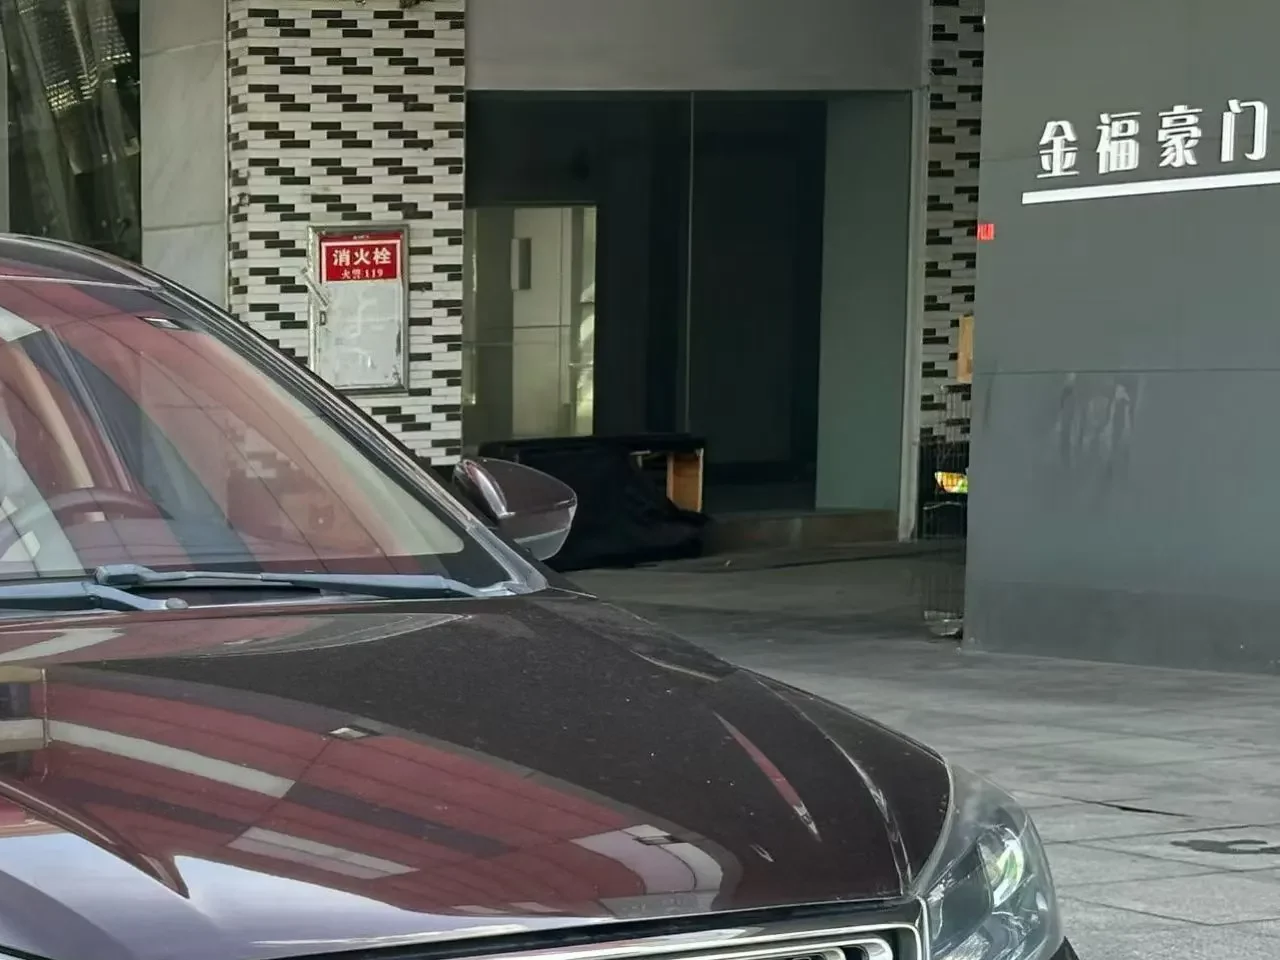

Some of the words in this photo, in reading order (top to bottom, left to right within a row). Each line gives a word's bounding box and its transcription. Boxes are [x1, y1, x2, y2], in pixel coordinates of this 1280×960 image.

[1036, 99, 1268, 179] 金福豪门
[332, 247, 392, 266] 消火栓
